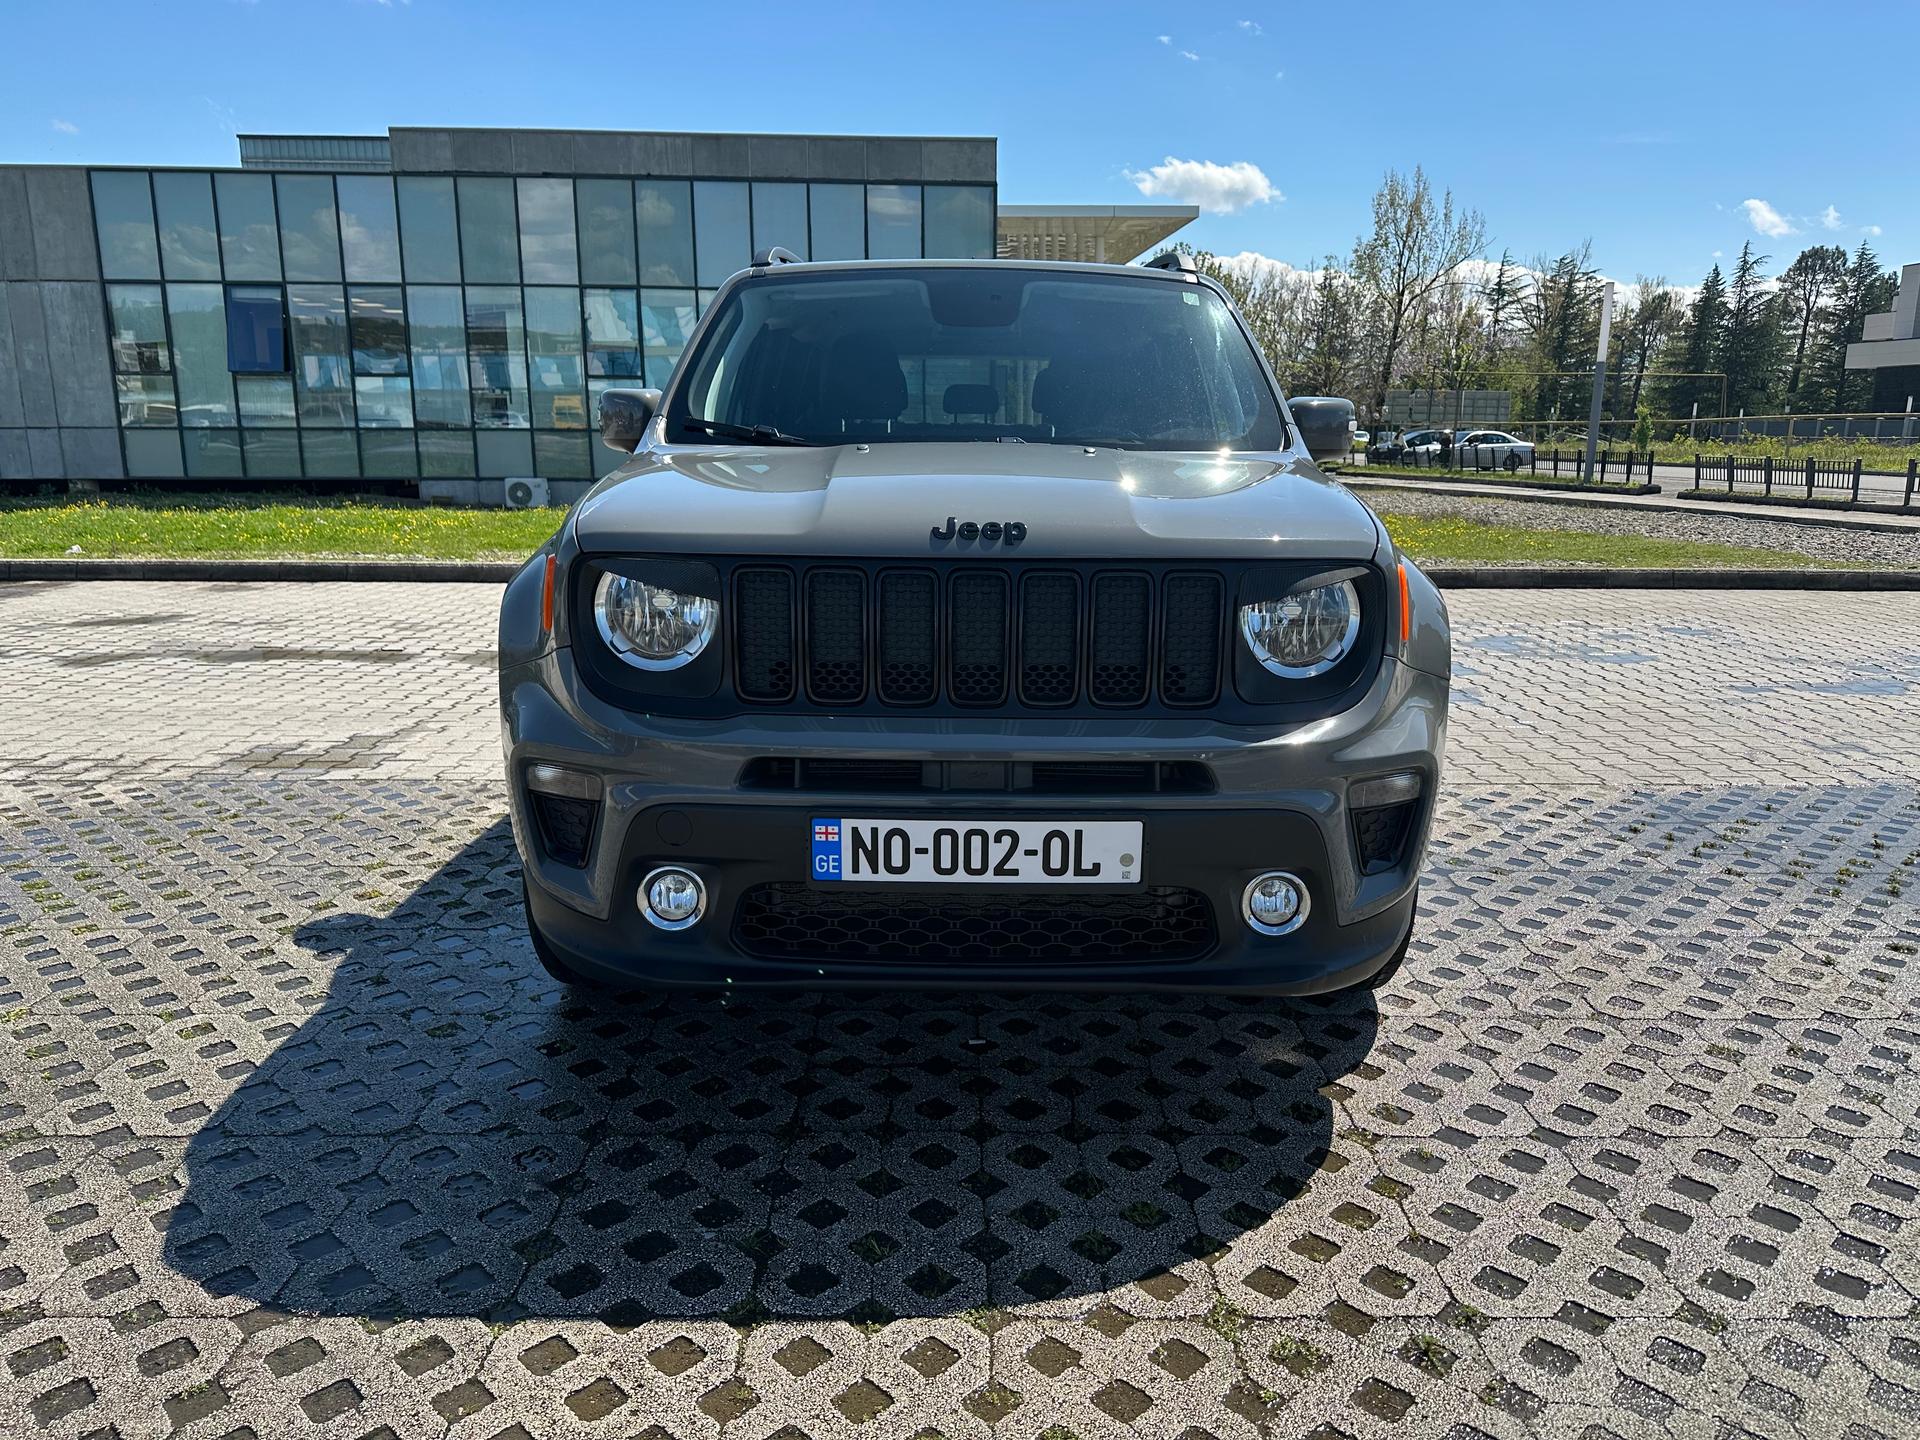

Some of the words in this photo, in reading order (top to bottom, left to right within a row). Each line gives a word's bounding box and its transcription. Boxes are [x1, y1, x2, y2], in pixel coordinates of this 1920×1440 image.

[931, 516, 1027, 546] Jeep
[815, 854, 840, 873] GE
[851, 826, 1101, 876] NO-002-OL
